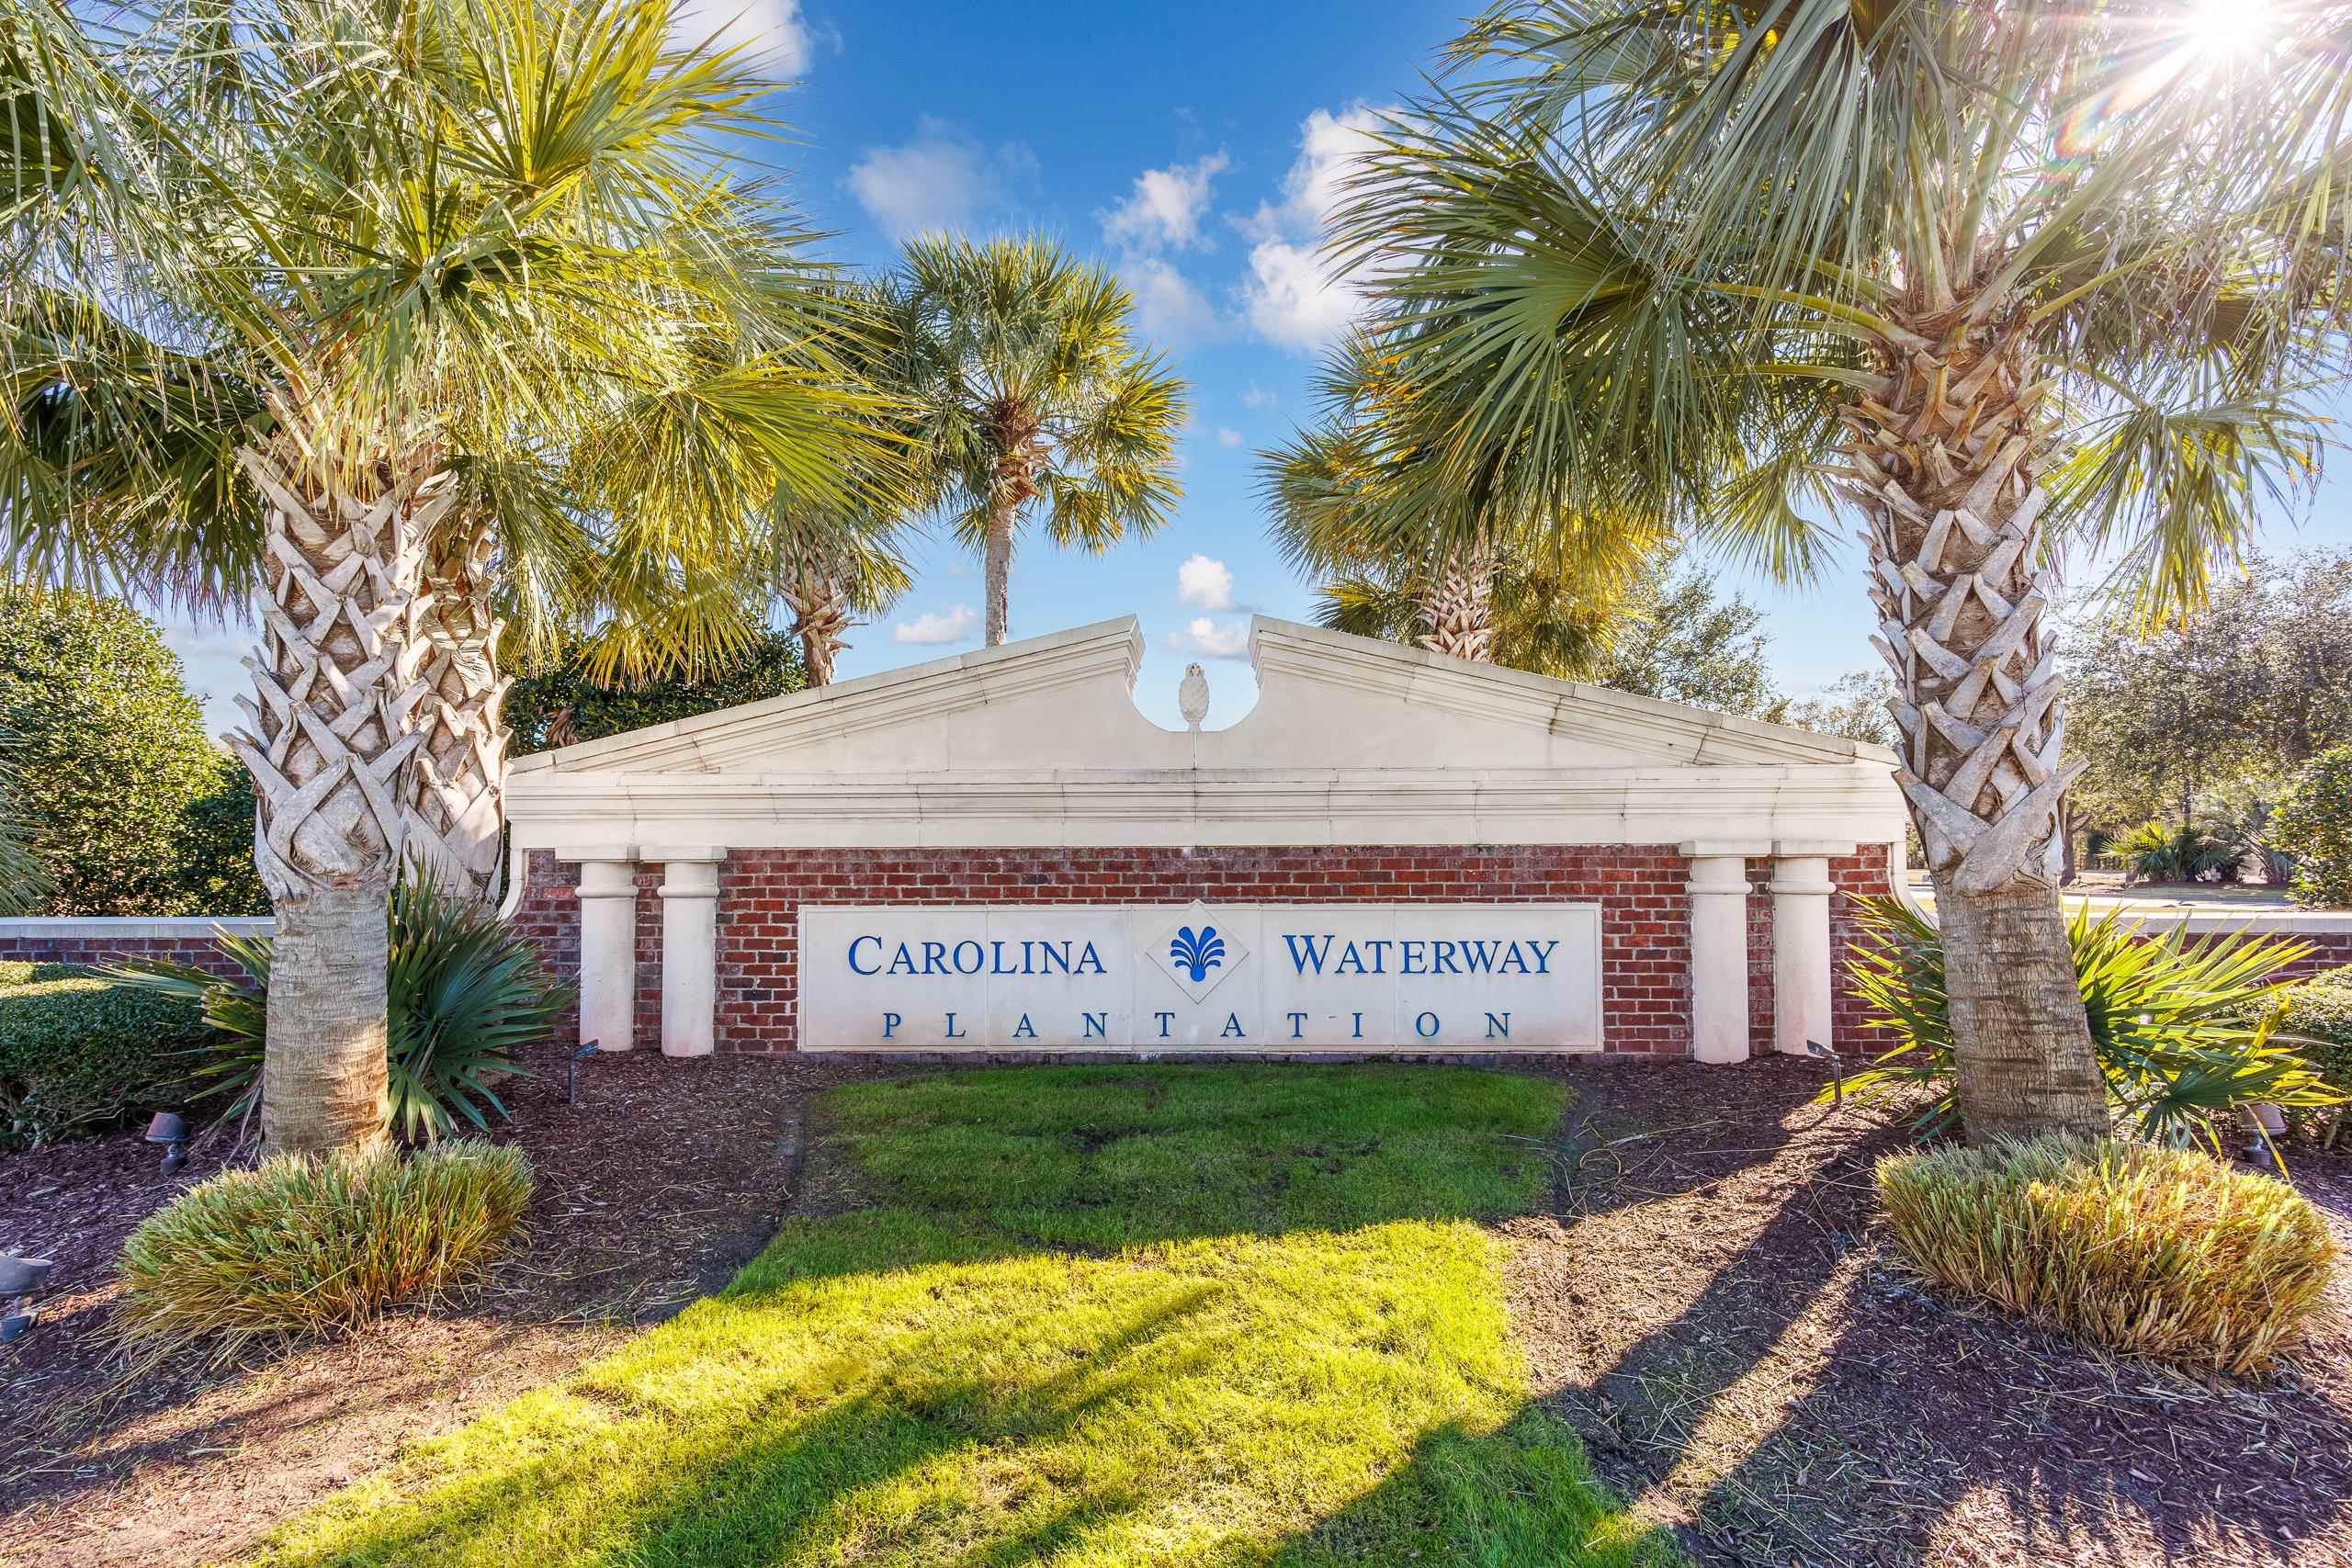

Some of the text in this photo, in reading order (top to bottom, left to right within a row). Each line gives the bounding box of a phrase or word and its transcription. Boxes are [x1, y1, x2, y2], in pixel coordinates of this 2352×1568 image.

[848, 934, 1560, 976] CAROLINA WATERWAY
[881, 1011, 1511, 1040] PLANTATION
